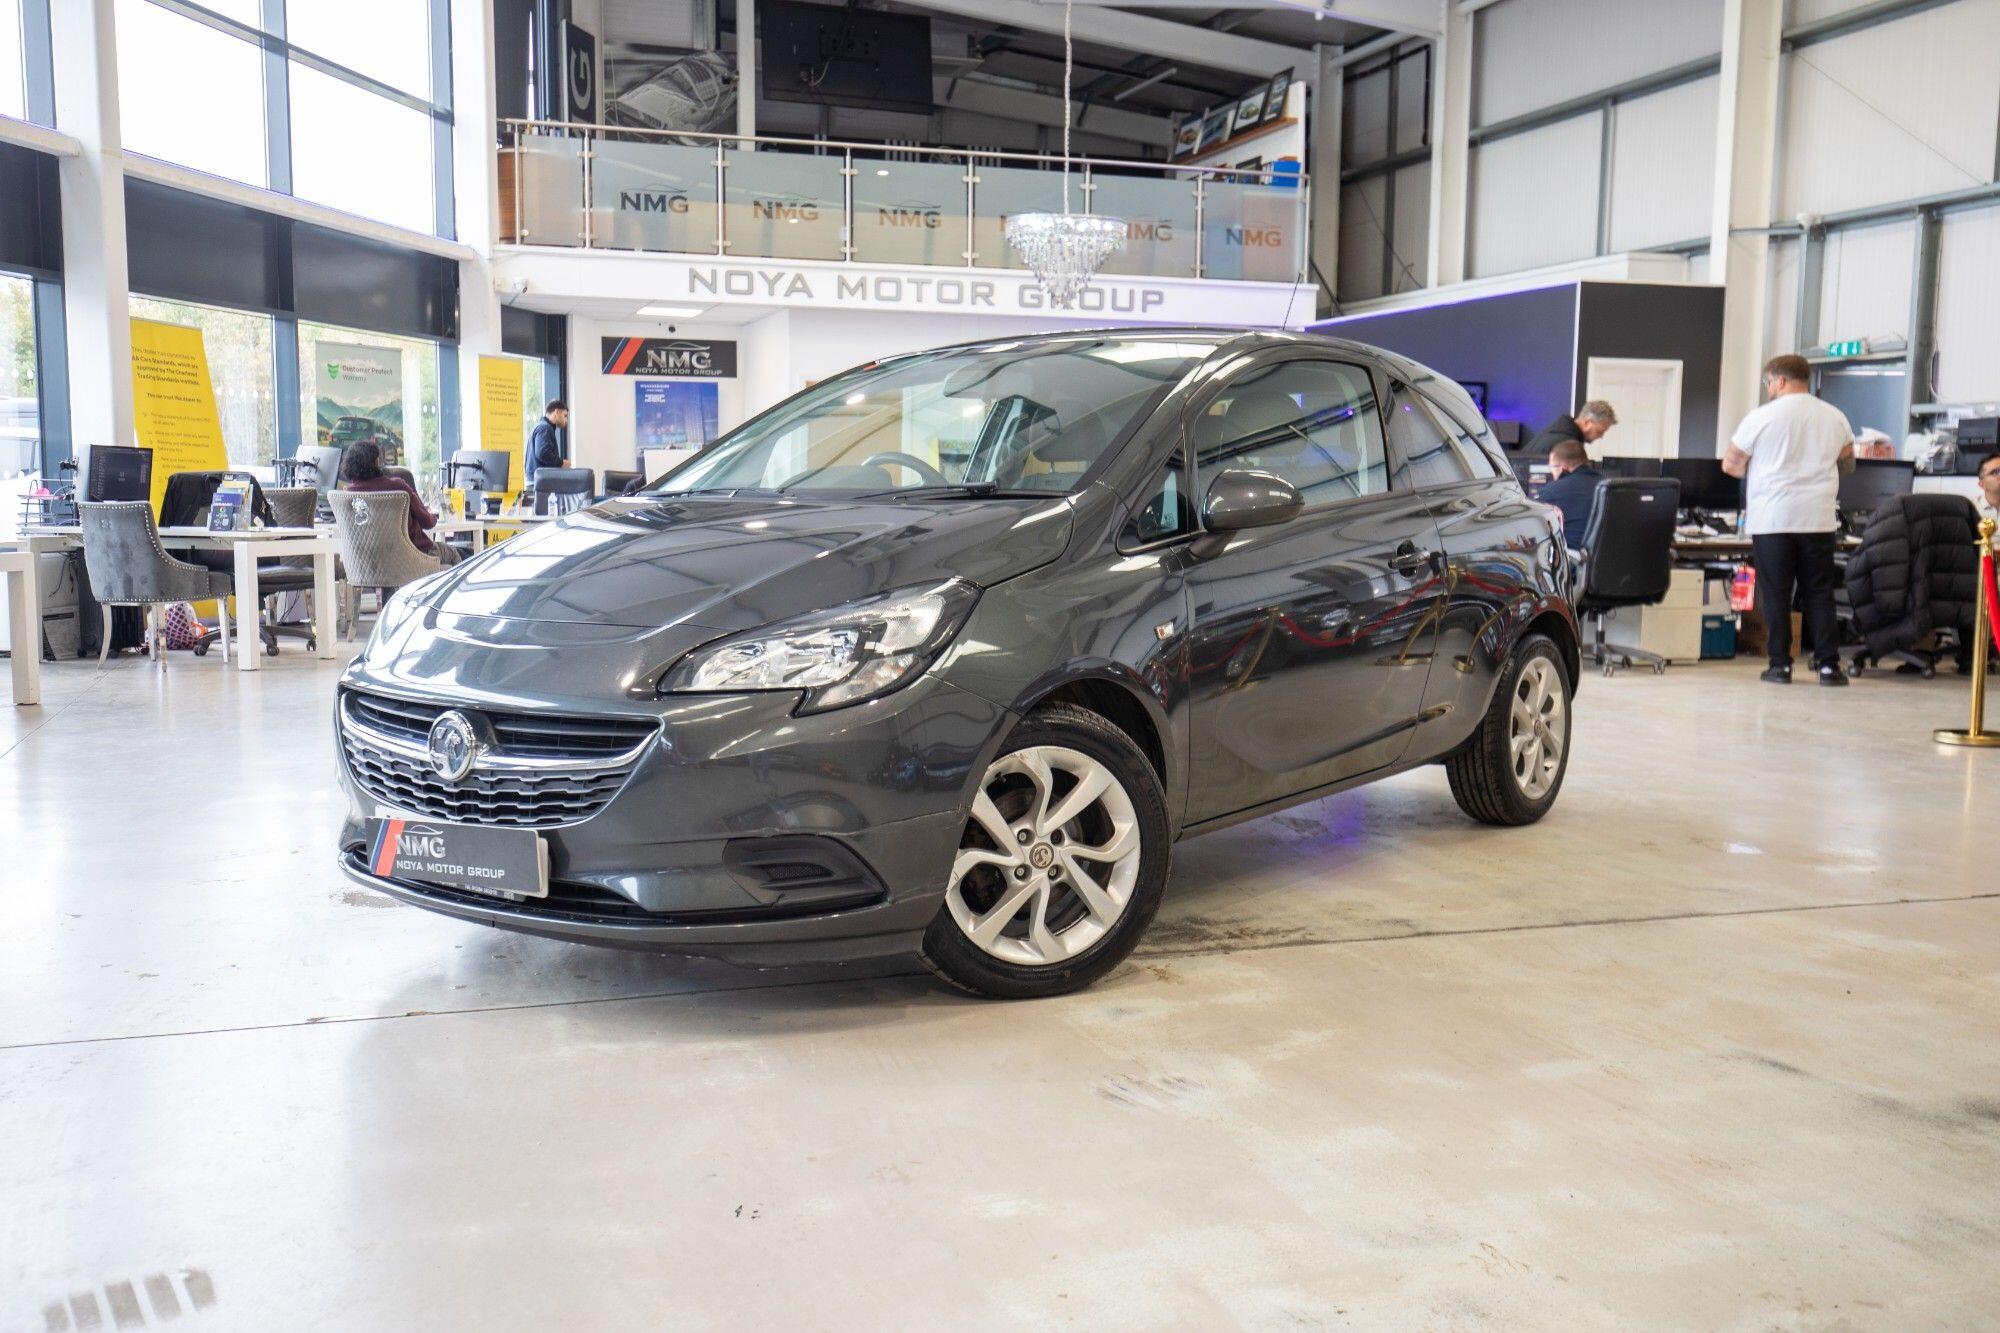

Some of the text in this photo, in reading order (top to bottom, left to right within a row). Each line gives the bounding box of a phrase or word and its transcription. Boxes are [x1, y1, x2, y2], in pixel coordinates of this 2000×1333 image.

[620, 191, 689, 214] NMG
[752, 200, 819, 221] NMG
[879, 207, 942, 228] NMG
[1226, 228, 1281, 247] NMG
[688, 267, 1165, 313] NOYA MOTOR GOUP
[647, 349, 712, 369] NMG
[371, 367, 393, 376] Protect
[394, 835, 446, 858] NMG
[396, 860, 506, 879] NOYA MOTOR GROUP
